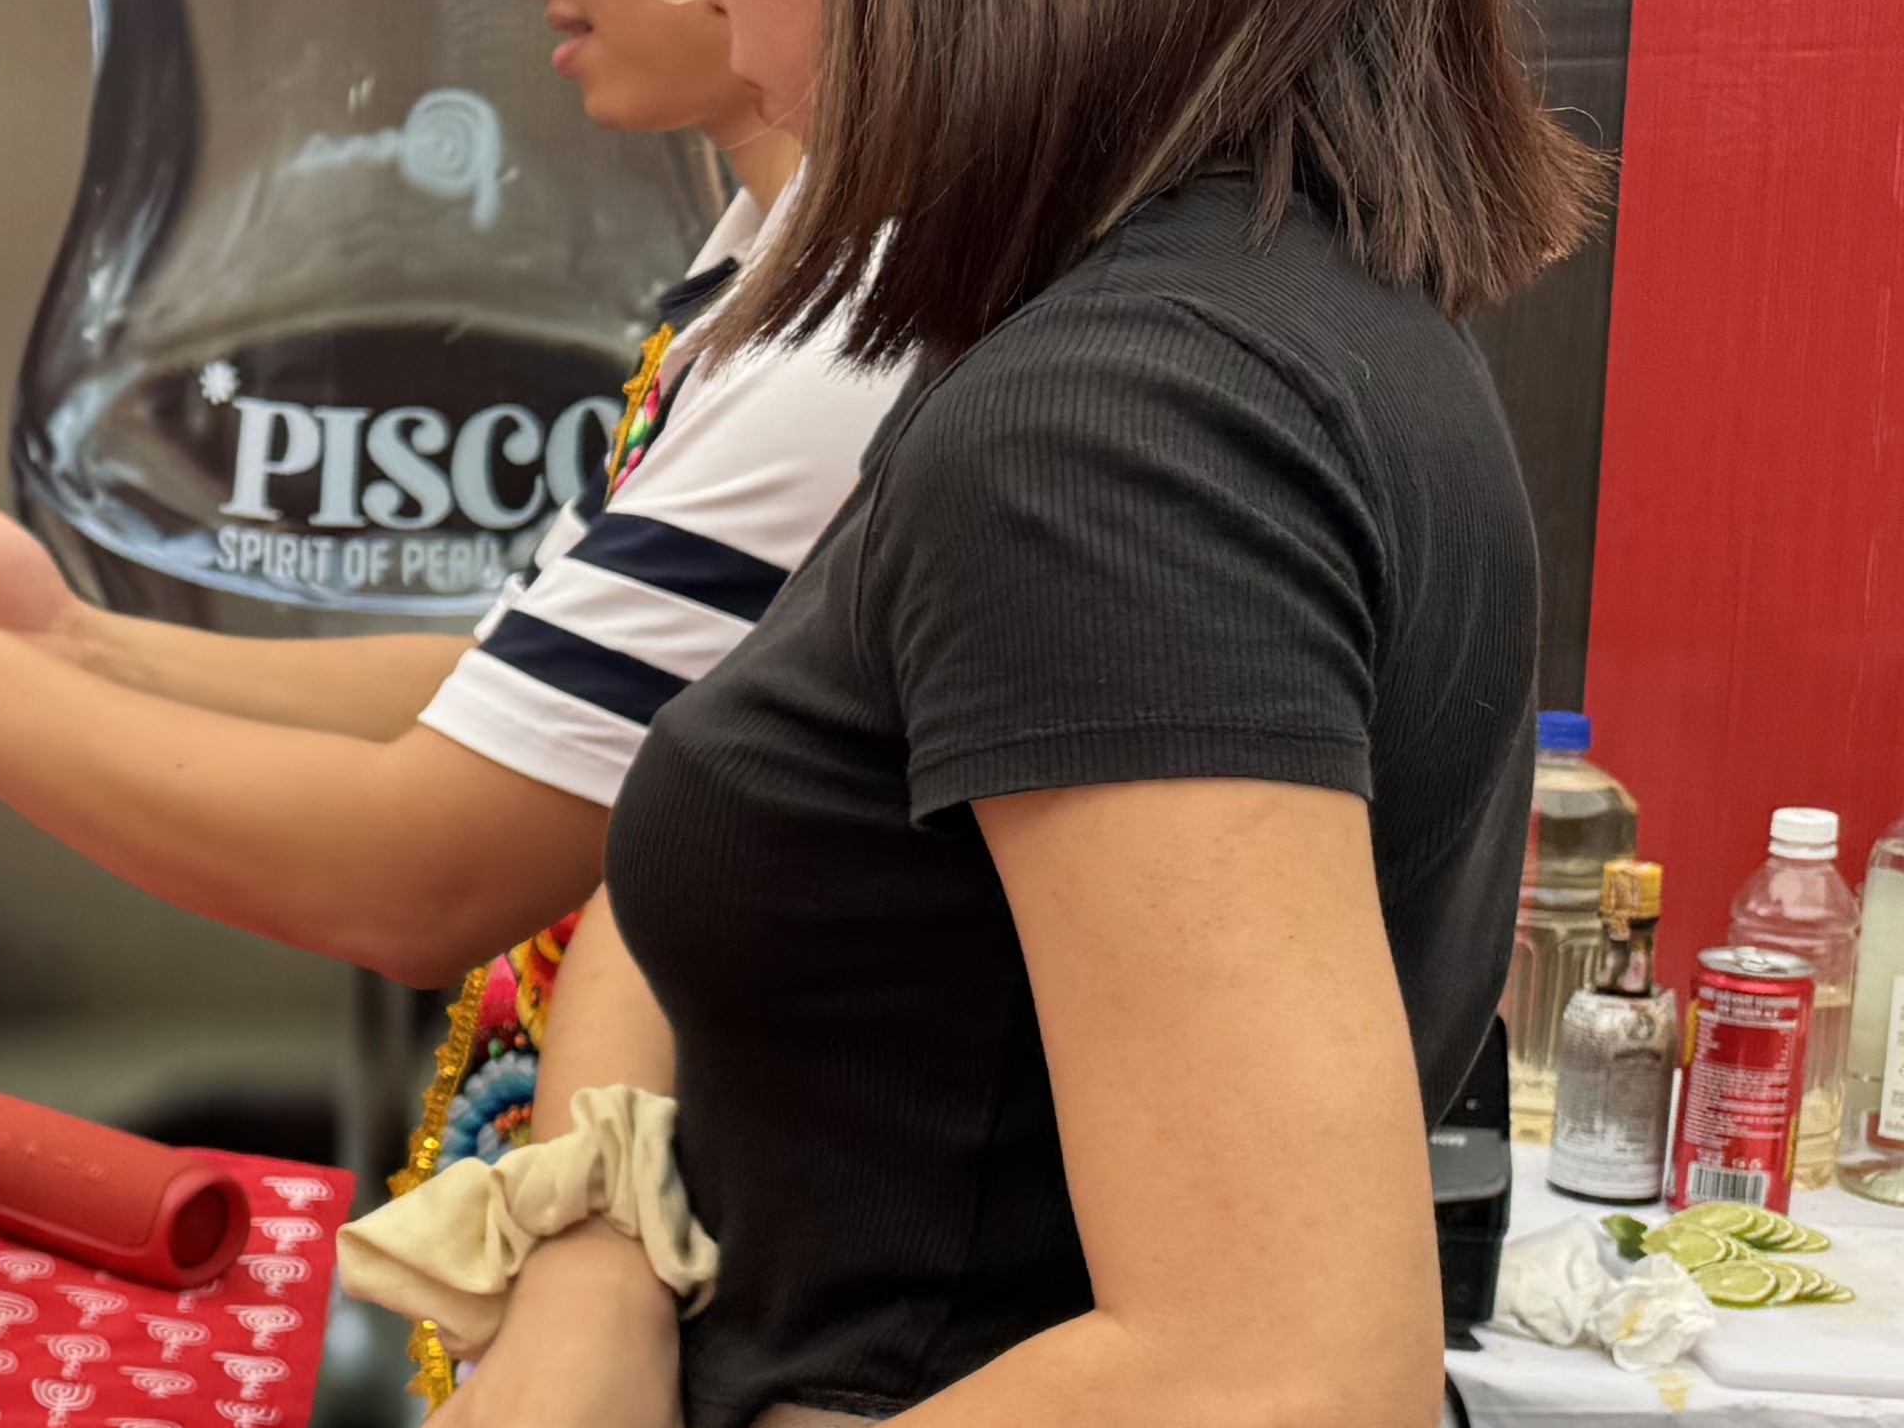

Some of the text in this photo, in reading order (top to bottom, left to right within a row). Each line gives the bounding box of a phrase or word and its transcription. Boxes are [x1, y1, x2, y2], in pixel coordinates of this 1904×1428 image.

[218, 395, 624, 530] PISCO
[216, 527, 336, 580] SPIRIT
[342, 537, 393, 587] OF
